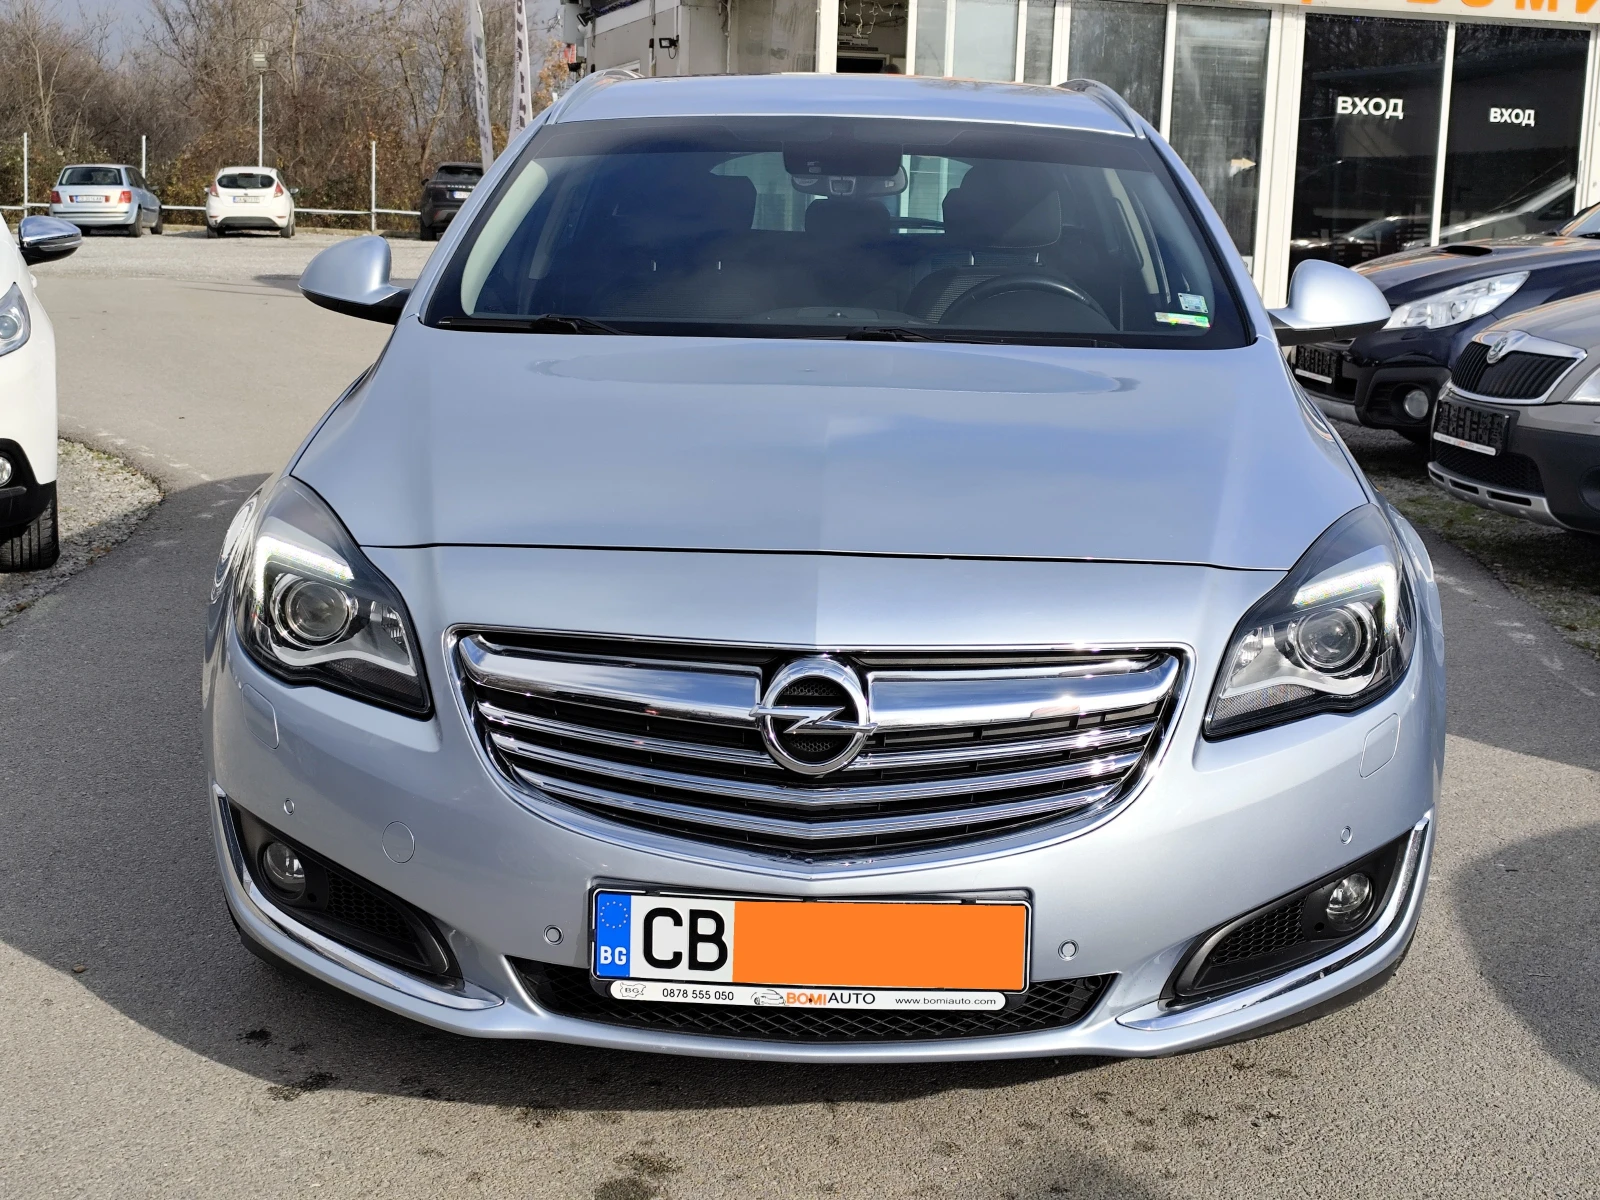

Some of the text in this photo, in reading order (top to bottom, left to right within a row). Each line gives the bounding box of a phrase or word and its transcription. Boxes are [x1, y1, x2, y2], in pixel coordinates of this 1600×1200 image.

[1336, 96, 1404, 120] ВХОД
[1489, 107, 1535, 127] ВХОД
[643, 907, 728, 971] CB
[600, 945, 627, 965] BG
[662, 988, 734, 1001] 0878 555 050
[895, 996, 997, 1006] www.bomiauto.com
